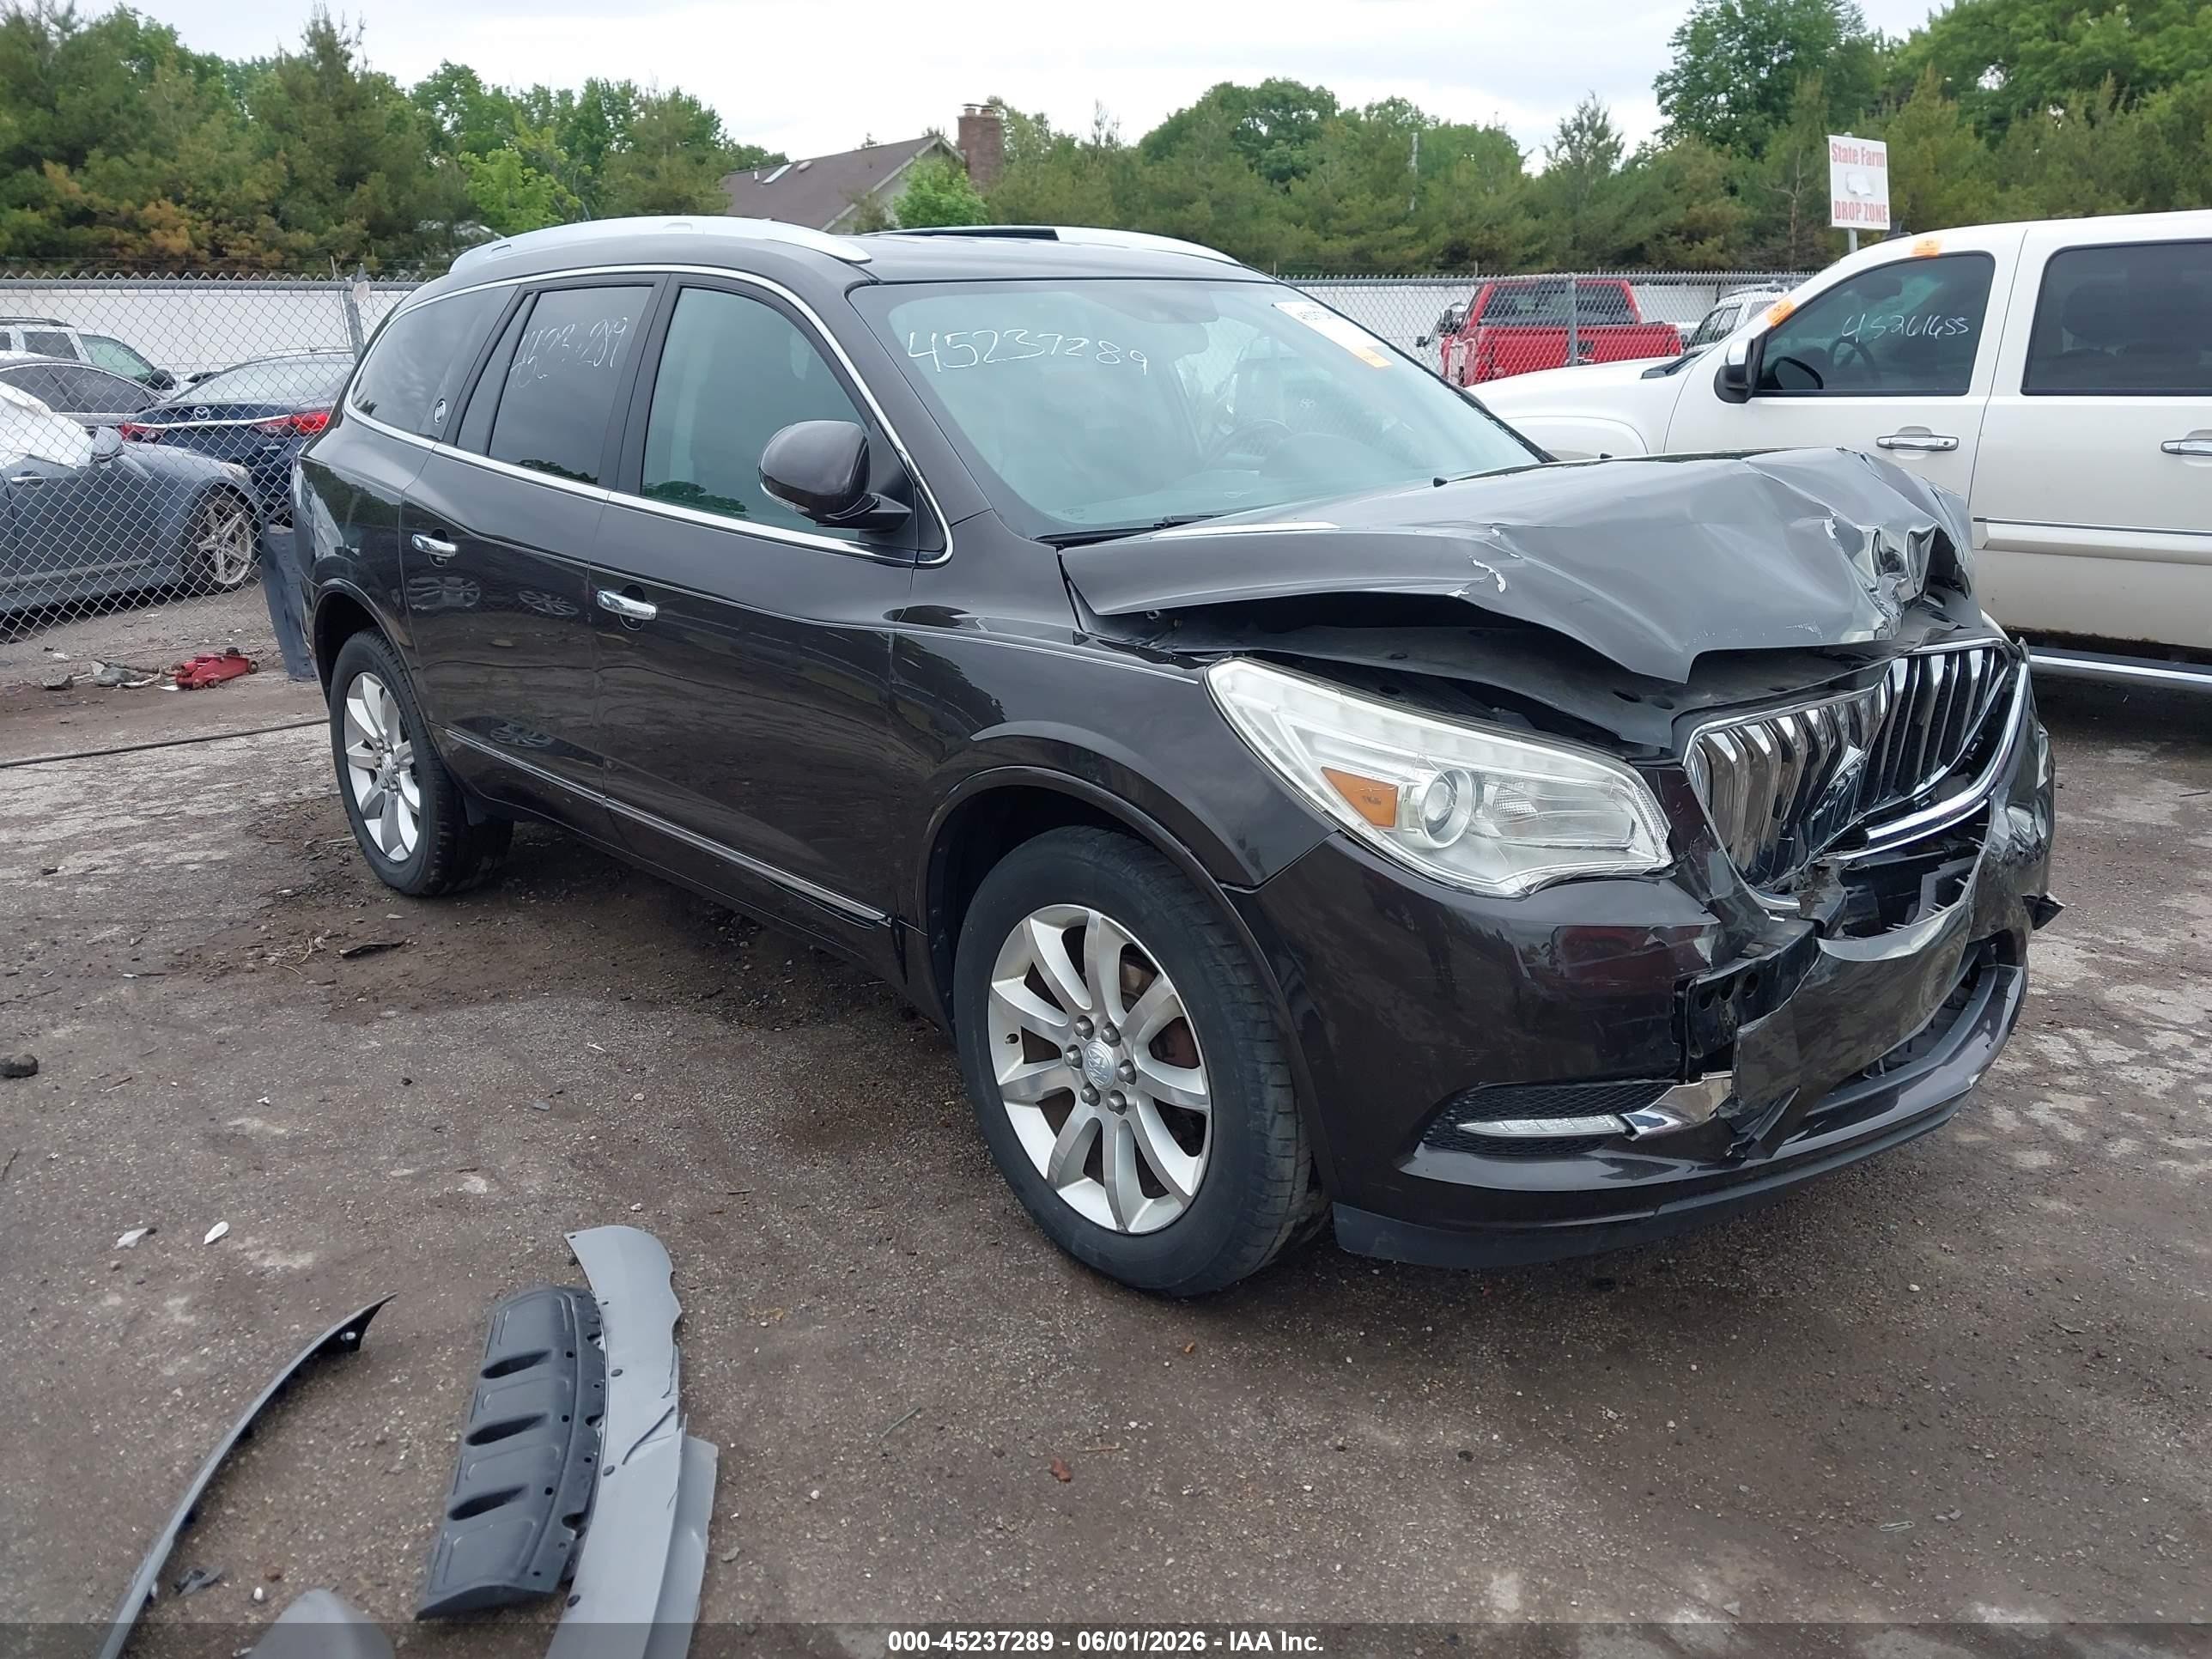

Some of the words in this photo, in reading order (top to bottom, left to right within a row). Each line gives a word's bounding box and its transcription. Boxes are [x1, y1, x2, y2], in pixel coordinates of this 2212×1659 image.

[1831, 143, 1858, 165] State
[1861, 146, 1886, 168] Farm
[1834, 200, 1862, 222] DROP
[1863, 203, 1887, 223] ZONE
[1841, 313, 1970, 343] 45261655
[908, 329, 1148, 375] 45237289
